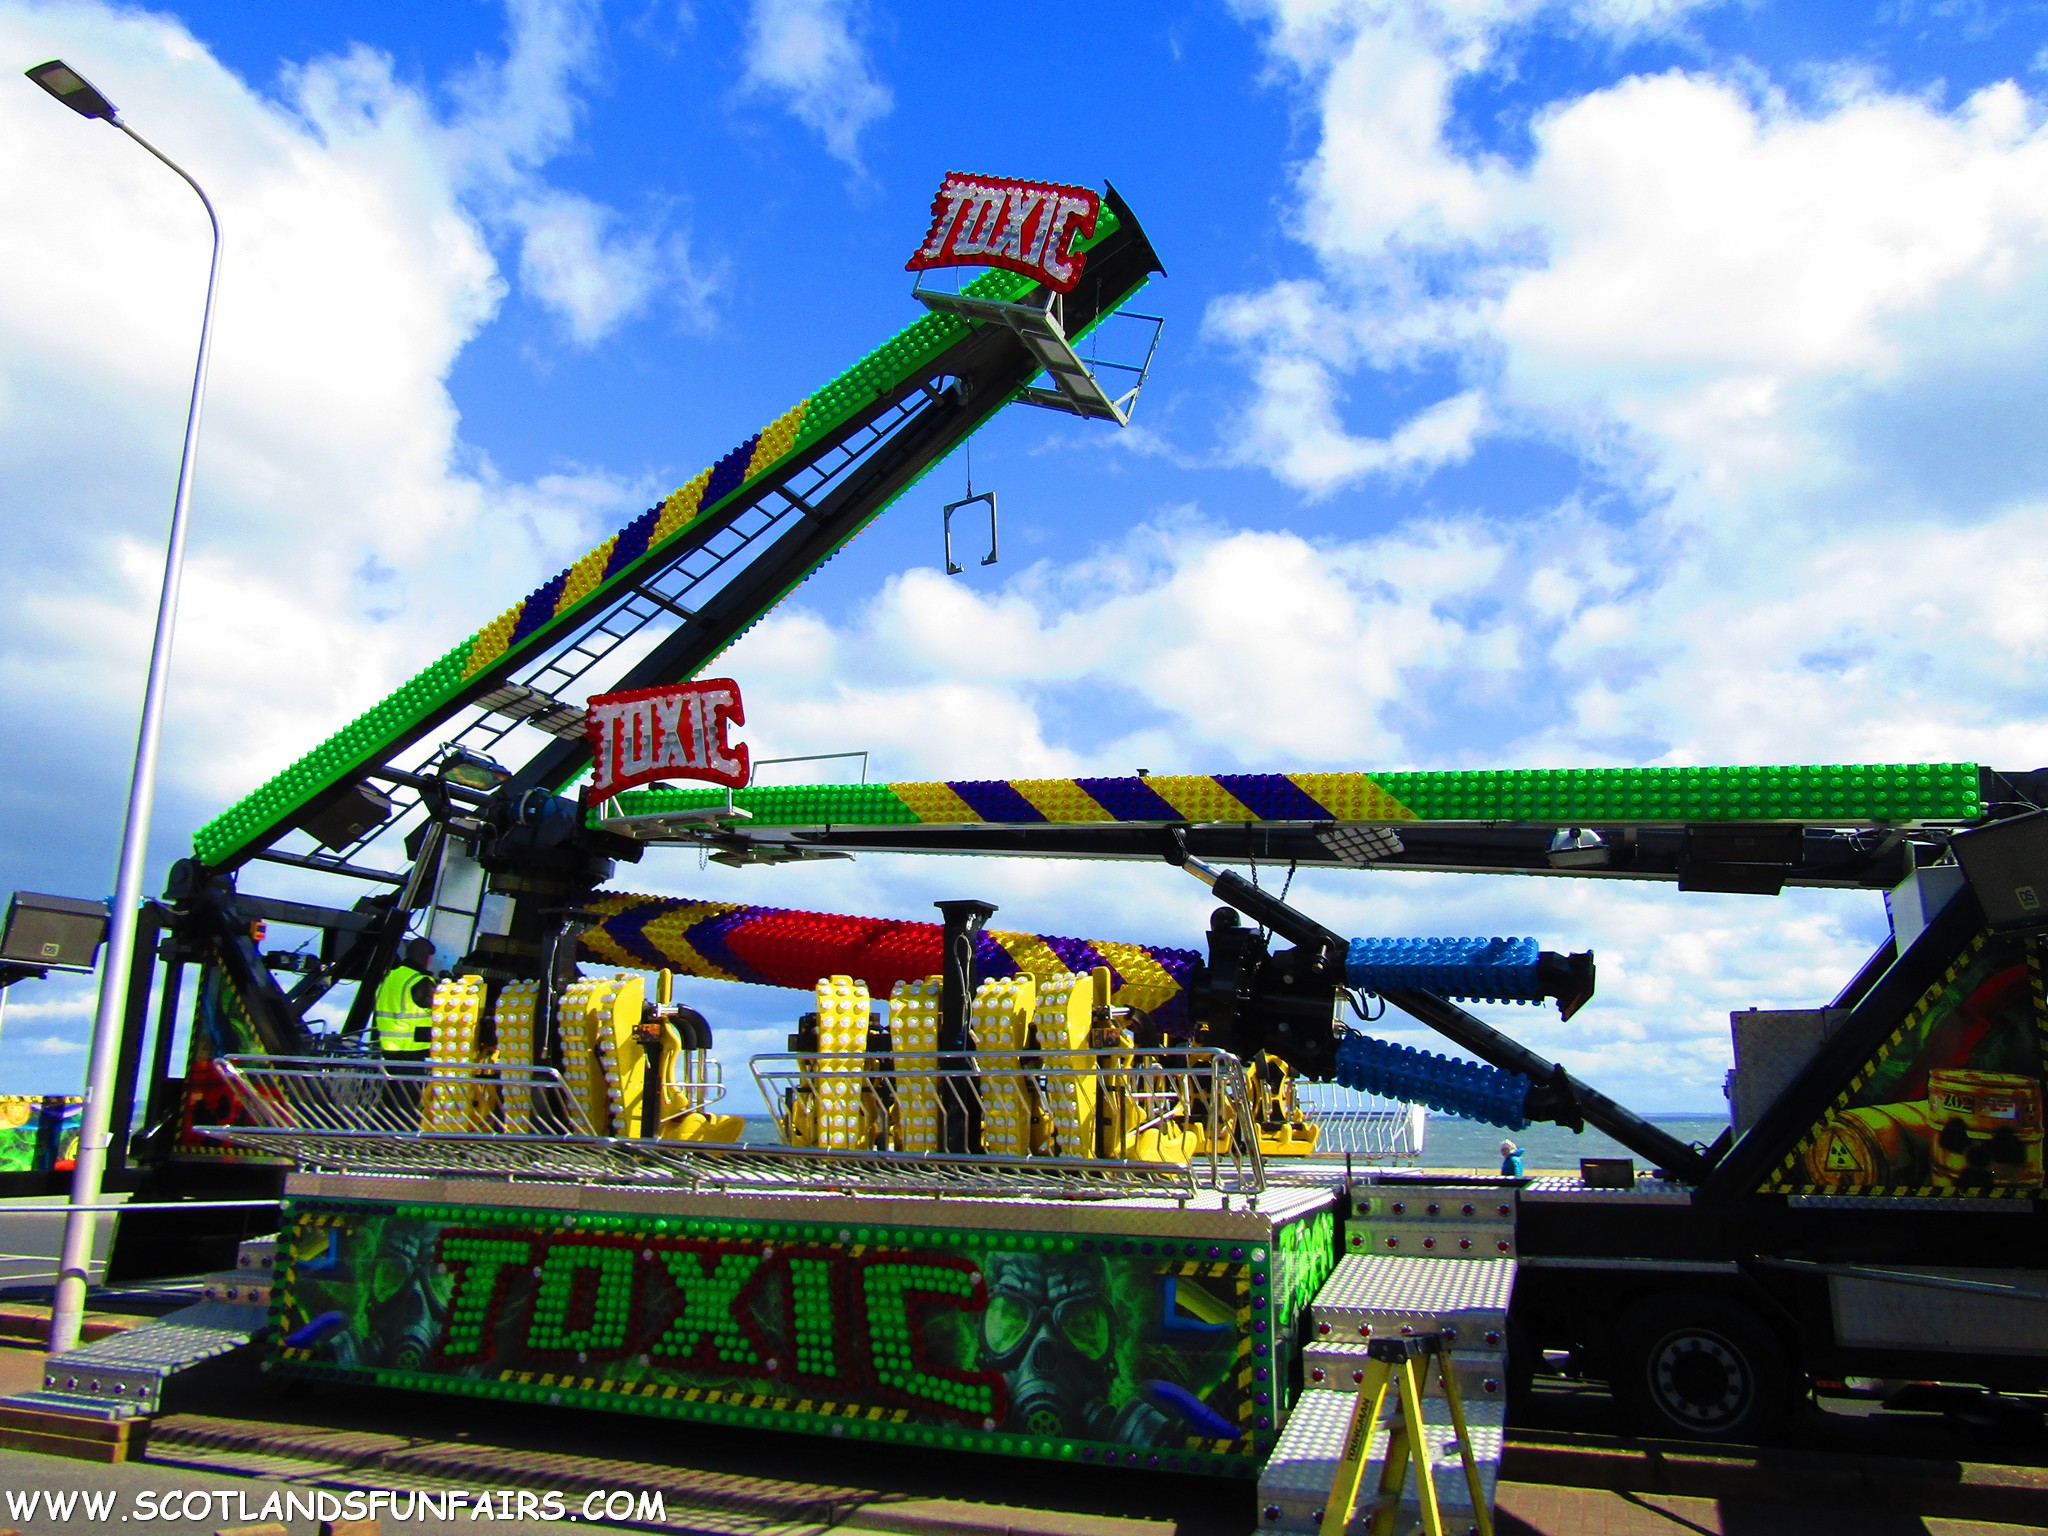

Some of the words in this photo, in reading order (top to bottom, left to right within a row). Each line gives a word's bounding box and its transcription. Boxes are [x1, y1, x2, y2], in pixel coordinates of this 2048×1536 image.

[920, 179, 1090, 284] TOXIC
[589, 689, 742, 790] TOXIC
[438, 1232, 998, 1418] TOXIC
[1346, 1397, 1370, 1461] YOUNGMAN
